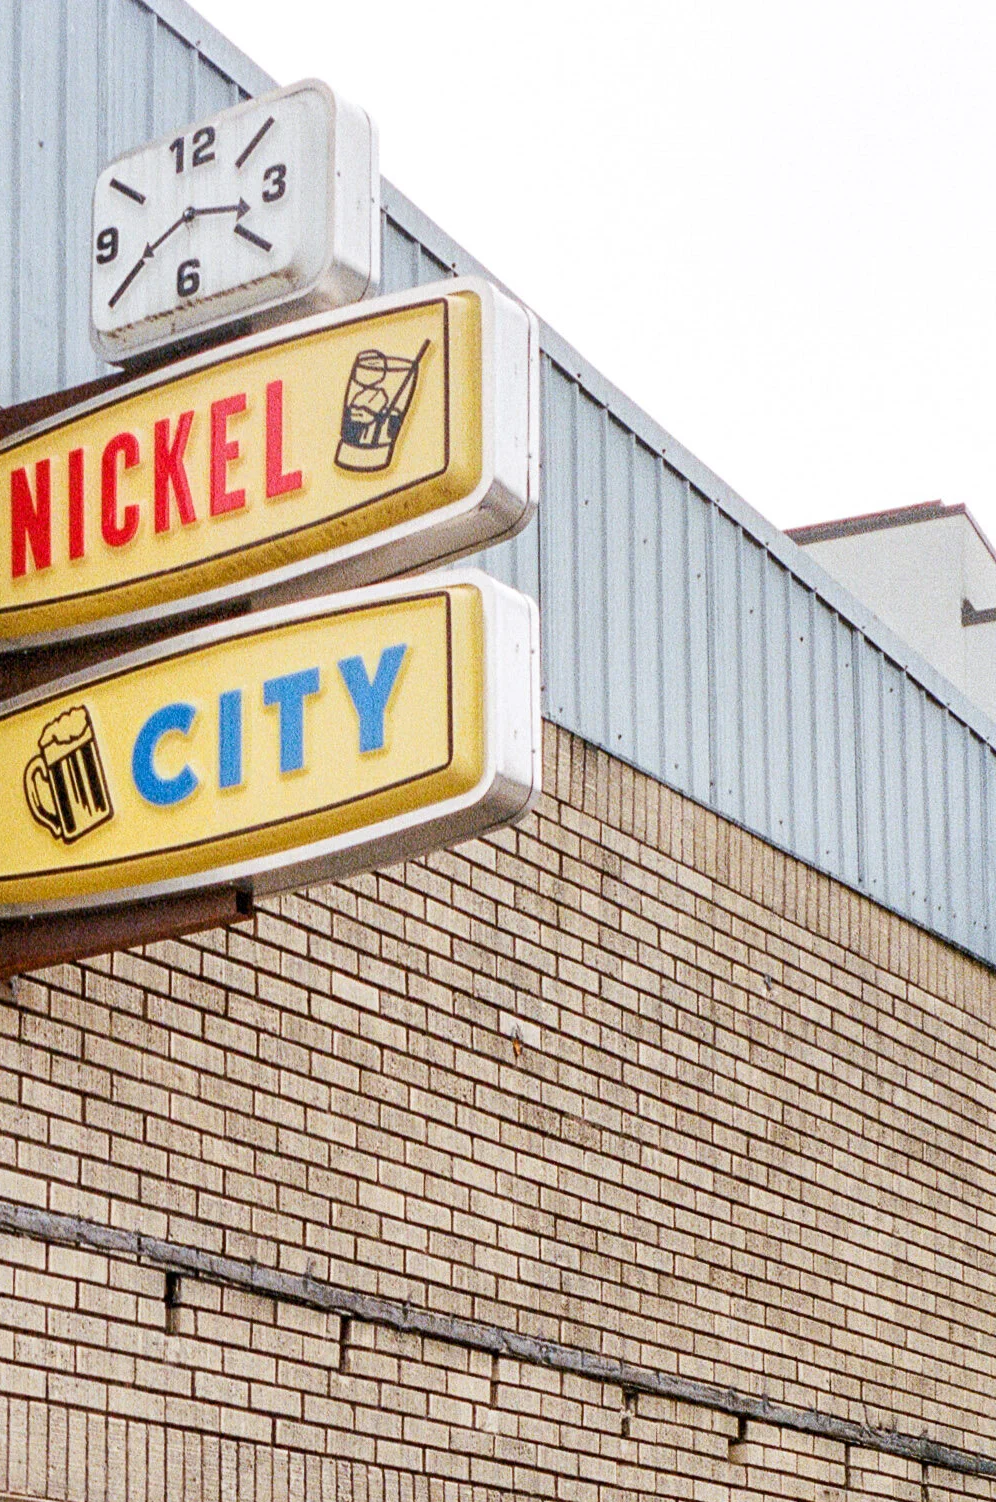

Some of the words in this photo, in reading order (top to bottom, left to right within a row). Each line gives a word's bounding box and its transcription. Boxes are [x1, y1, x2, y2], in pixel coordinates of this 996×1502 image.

[169, 126, 216, 174] 12
[262, 164, 287, 203] 3
[96, 227, 119, 265] 9
[176, 258, 201, 297] 6
[10, 379, 303, 580] NICKEL
[131, 643, 408, 807] CITY
